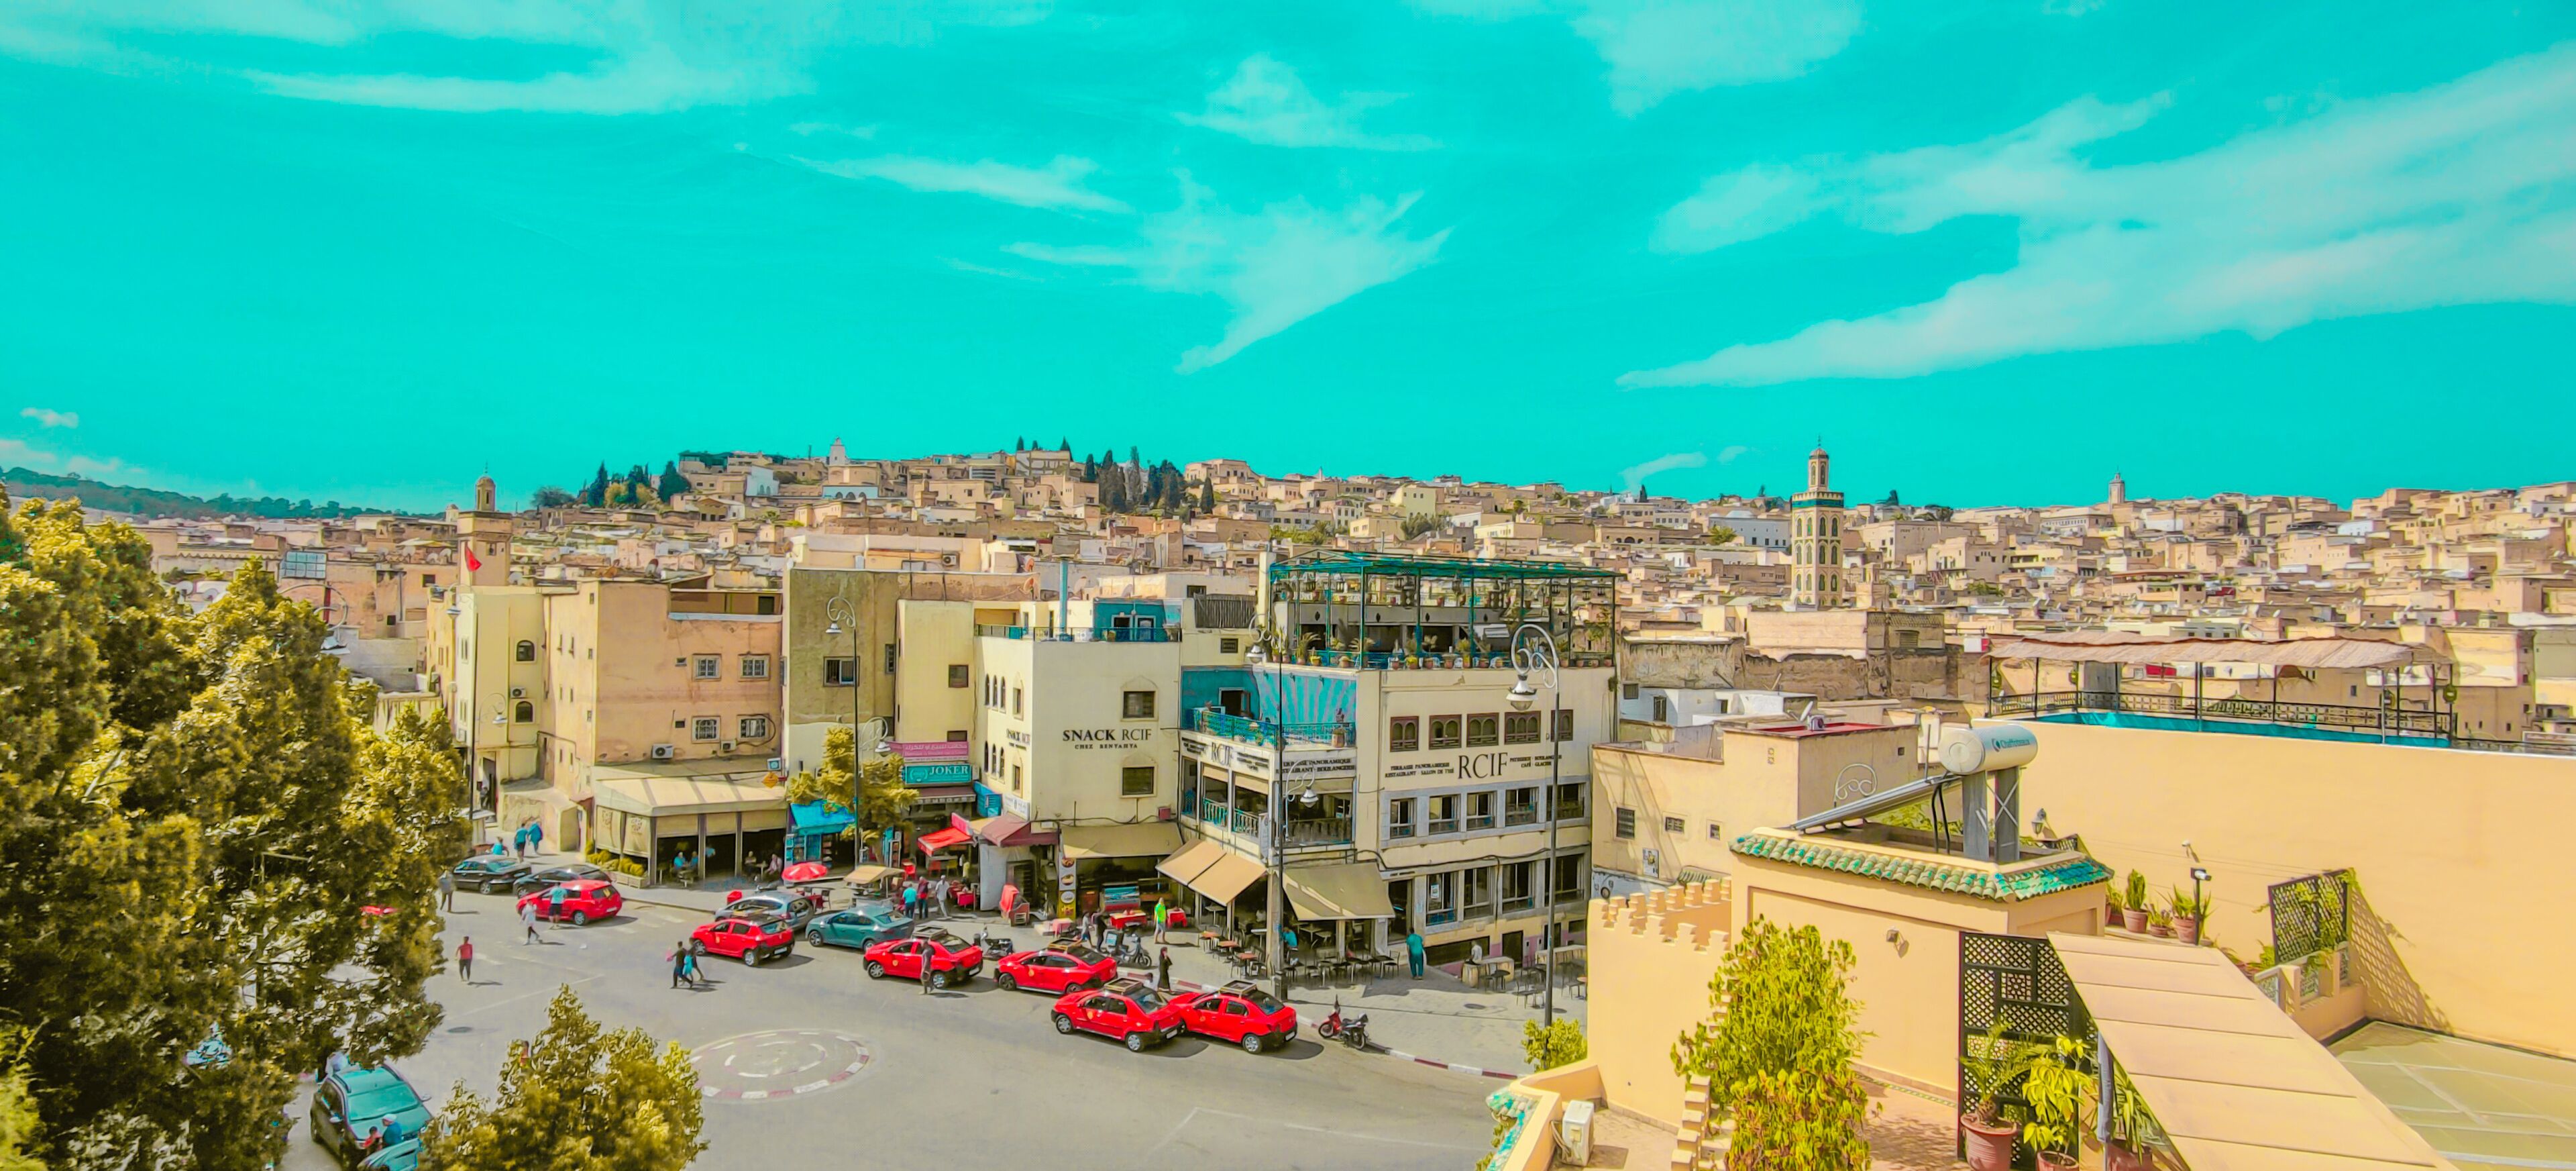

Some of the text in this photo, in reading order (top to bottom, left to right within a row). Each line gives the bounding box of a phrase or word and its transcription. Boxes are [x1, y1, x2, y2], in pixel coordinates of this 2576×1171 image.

[1063, 729, 1152, 741] SNACK RCIF
[929, 766, 969, 775] JOKER
[1458, 752, 1508, 778] RCIF
